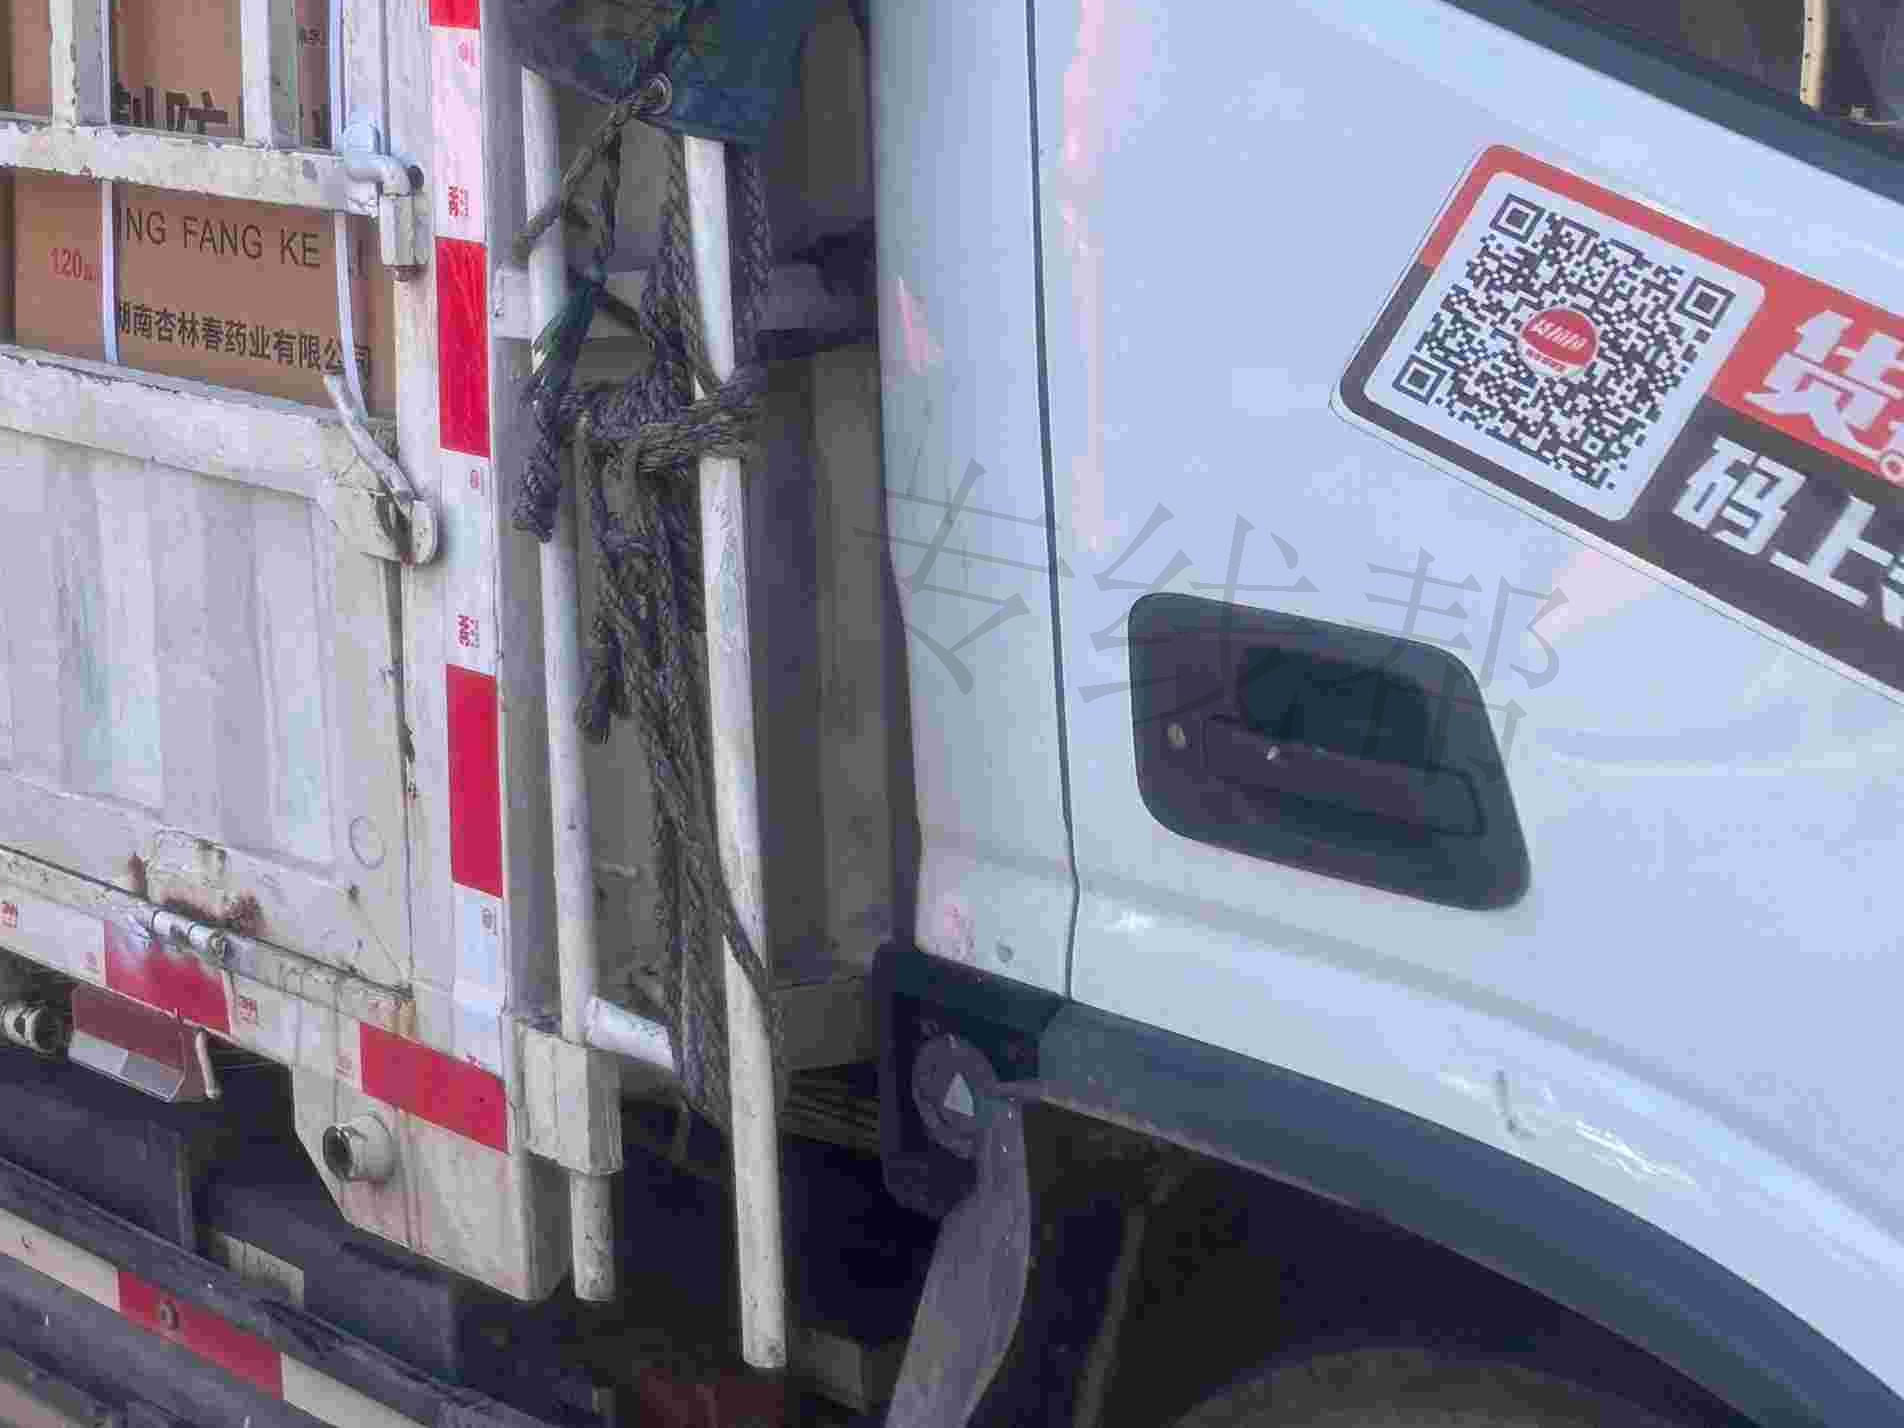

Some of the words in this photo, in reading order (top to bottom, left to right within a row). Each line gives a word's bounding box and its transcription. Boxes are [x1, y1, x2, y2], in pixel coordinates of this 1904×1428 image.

[183, 215, 263, 260] FANG
[280, 227, 321, 269] KE
[1673, 435, 1904, 630] 码上
